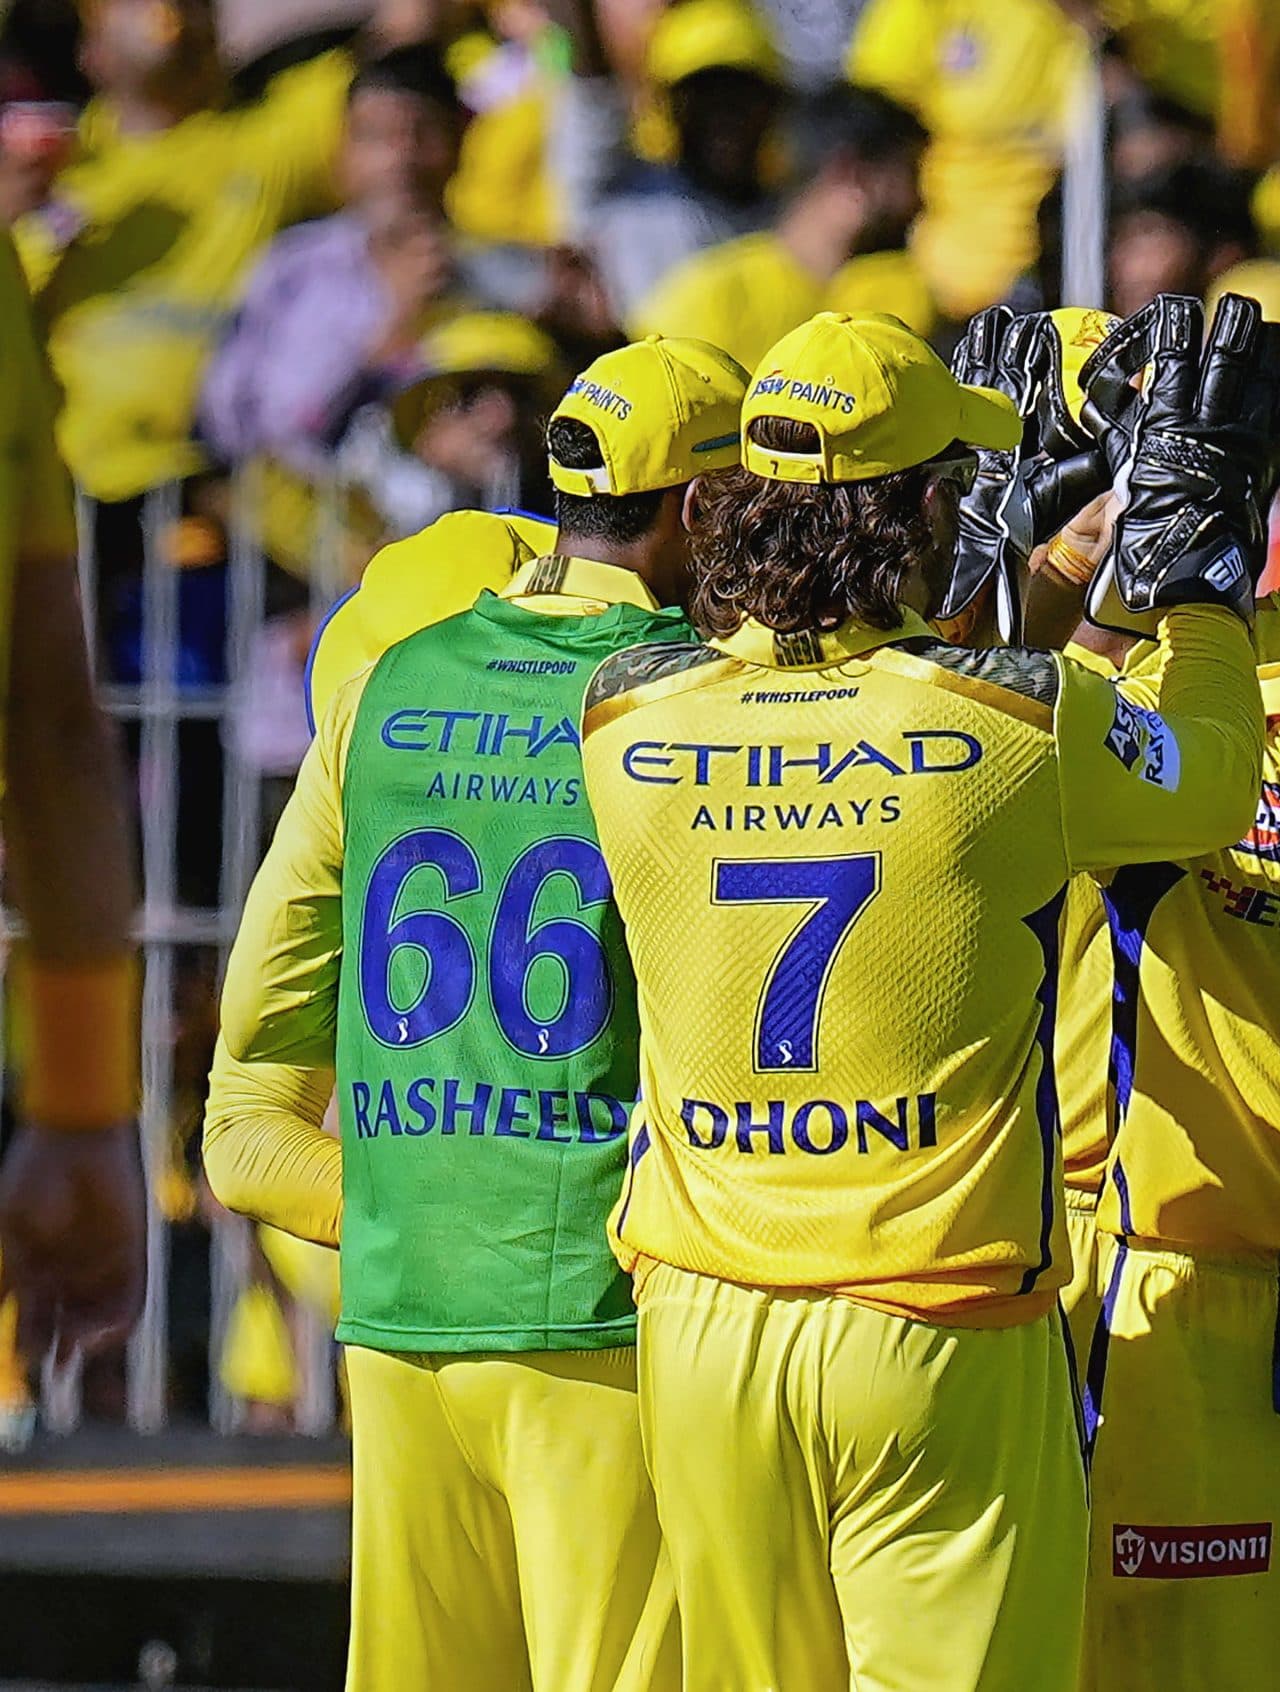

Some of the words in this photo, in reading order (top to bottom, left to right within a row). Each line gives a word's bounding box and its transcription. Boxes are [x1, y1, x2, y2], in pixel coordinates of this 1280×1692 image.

[582, 383, 632, 420] PAINTS
[788, 382, 856, 414] PAINTS
[769, 460, 779, 475] 7
[486, 659, 577, 674] #WHISTLEPODU
[740, 687, 859, 704] #WHISTLEPODU
[622, 730, 984, 787] ETIHAD
[427, 772, 580, 806] AIRWAYS
[691, 796, 901, 832] AIRWAYS
[358, 826, 615, 1061] 66
[710, 850, 882, 1073] 7
[352, 1078, 628, 1143] RASHEED
[680, 1092, 937, 1155] DHONI
[1151, 1536, 1267, 1564] VISION11
